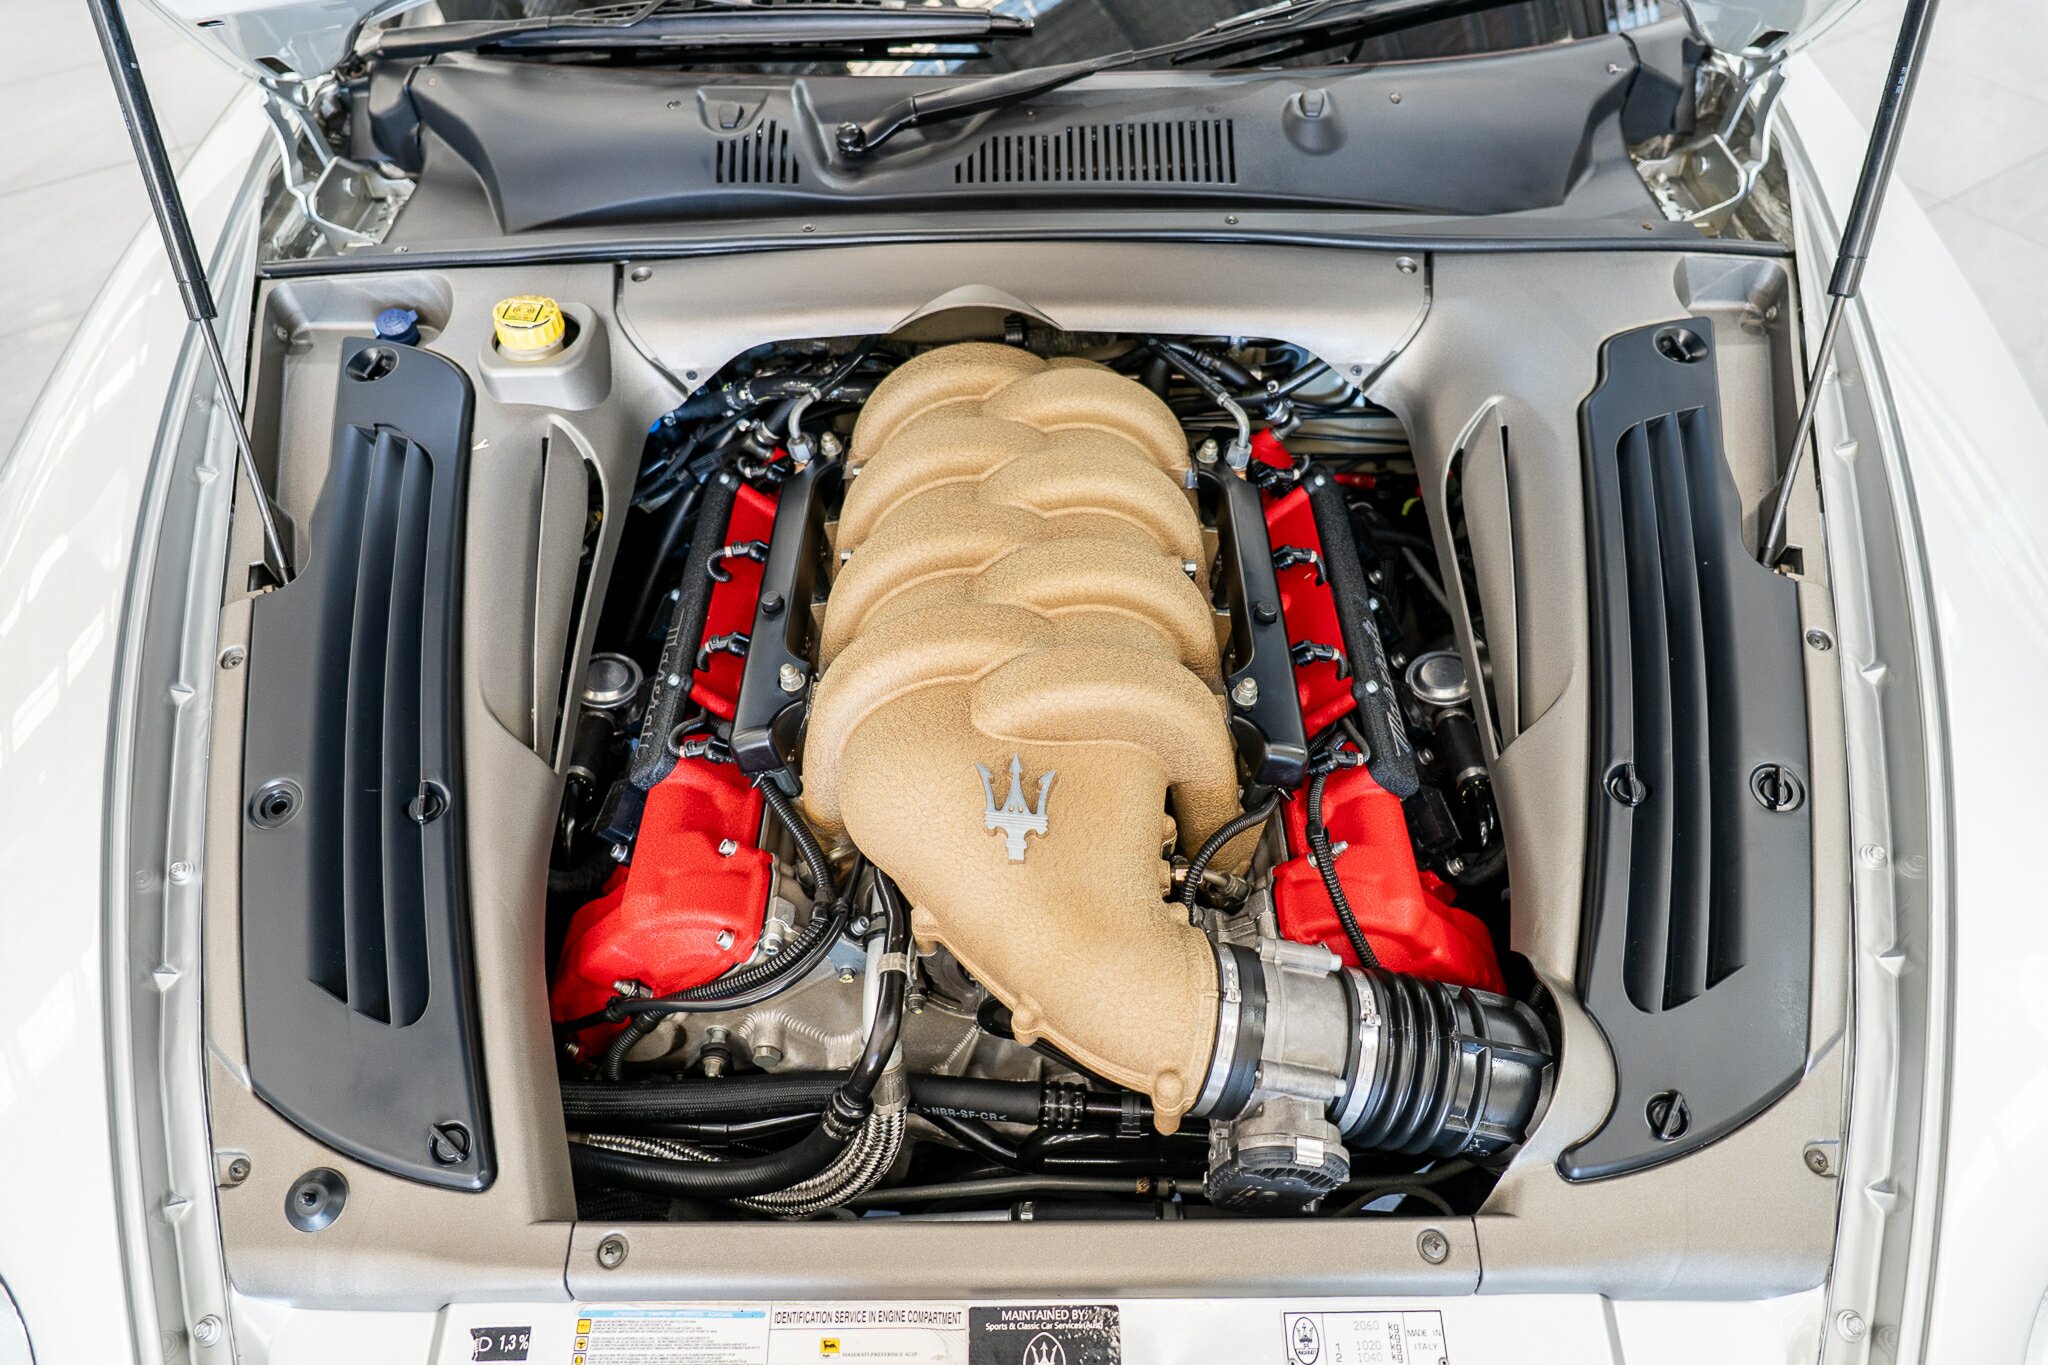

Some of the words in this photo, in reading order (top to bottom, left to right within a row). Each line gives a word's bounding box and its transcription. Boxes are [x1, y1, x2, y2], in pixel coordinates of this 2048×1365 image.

[774, 1311, 833, 1324] IDENTIFICATION
[835, 1311, 866, 1323] SERVICE
[868, 1311, 877, 1323] IN
[878, 1310, 906, 1323] ENGINE
[908, 1310, 962, 1325] COMPARTMENT
[1001, 1309, 1069, 1320] MAINTAINED
[985, 1322, 1008, 1332] Sports
[1009, 1322, 1016, 1330] &
[1017, 1322, 1040, 1330] Classic
[1041, 1322, 1053, 1330] Car
[1354, 1320, 1380, 1331] 2060
[1388, 1322, 1399, 1333] kg
[1389, 1332, 1401, 1343] kg
[1336, 1343, 1340, 1351] 1
[1356, 1340, 1382, 1351] 1020
[1391, 1343, 1402, 1353] kg
[1414, 1343, 1438, 1351] ITALY
[1336, 1353, 1342, 1362] 2
[1358, 1352, 1383, 1363] 1040
[1392, 1352, 1403, 1363] kg
